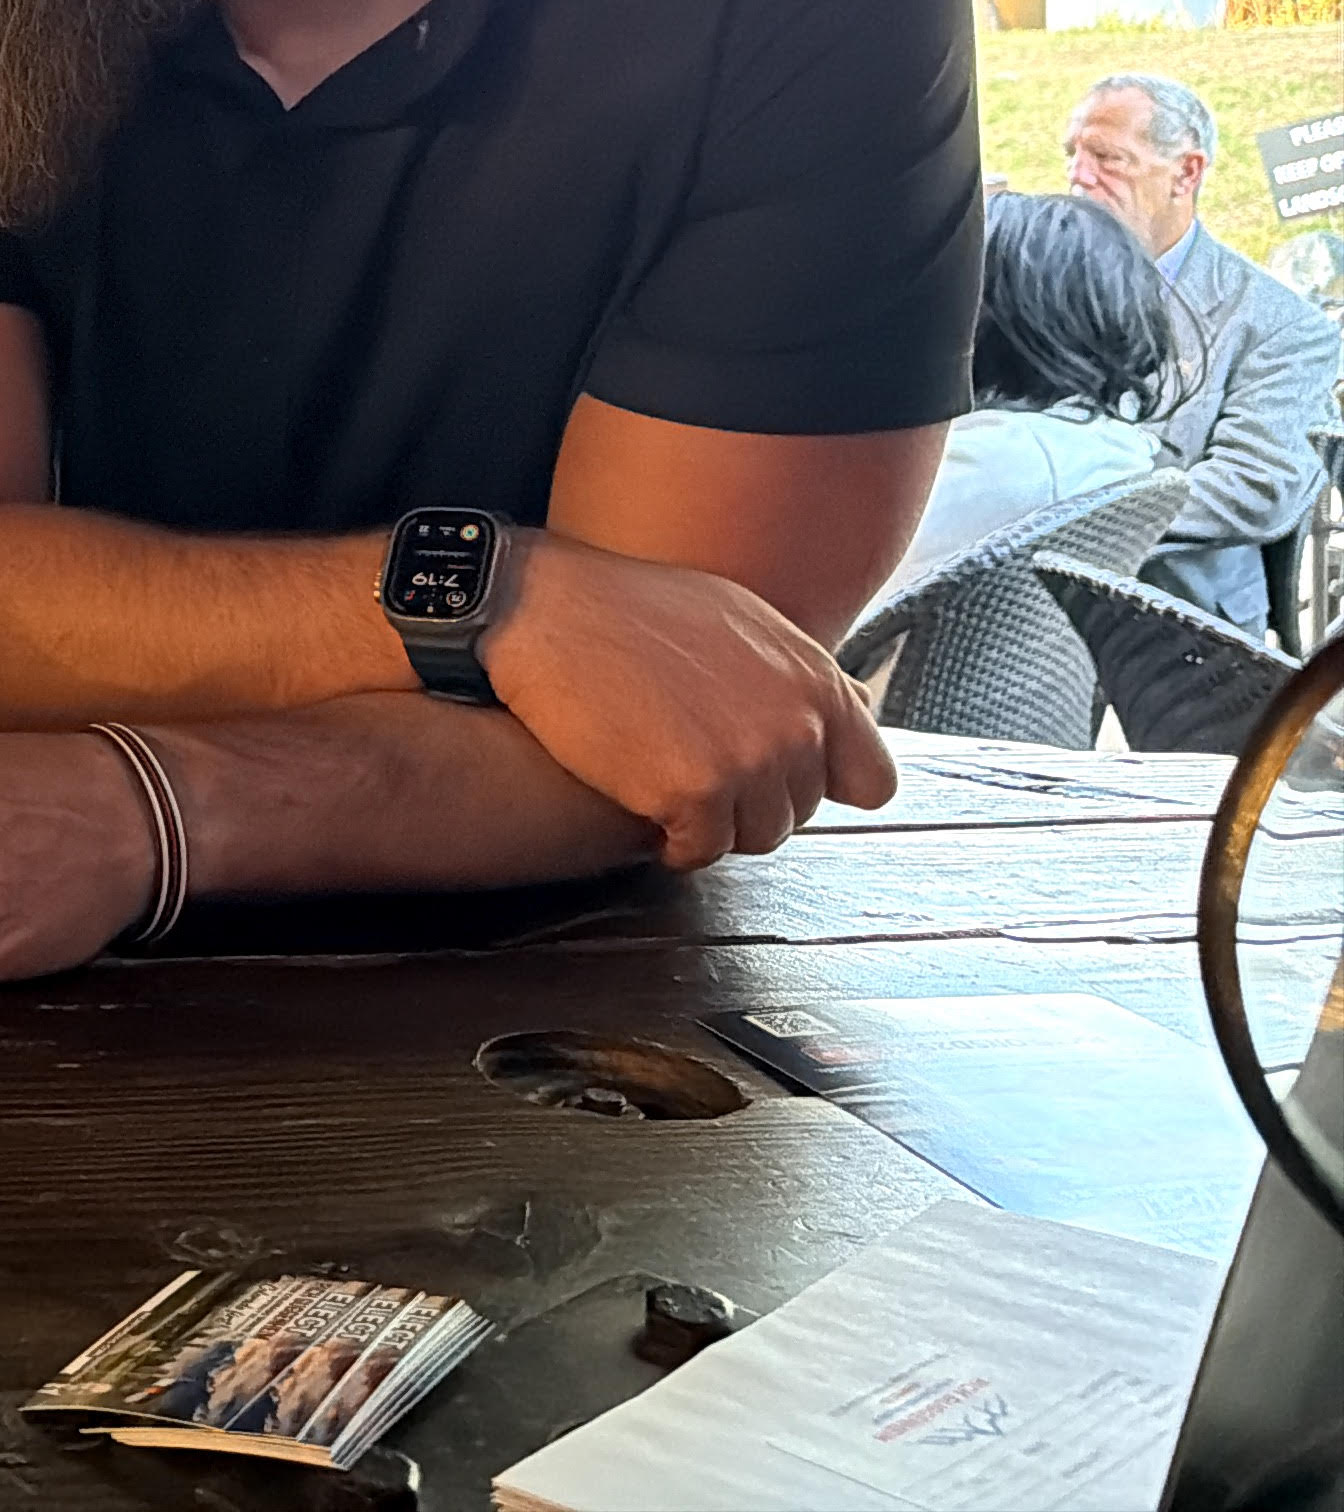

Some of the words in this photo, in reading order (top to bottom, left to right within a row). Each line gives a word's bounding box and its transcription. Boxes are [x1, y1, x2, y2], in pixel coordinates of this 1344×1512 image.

[1273, 157, 1318, 184] KEEP
[412, 571, 460, 588] 7:19
[285, 1292, 355, 1338] ELECT
[334, 1298, 401, 1343] ELECT
[378, 1306, 440, 1350] ELECT
